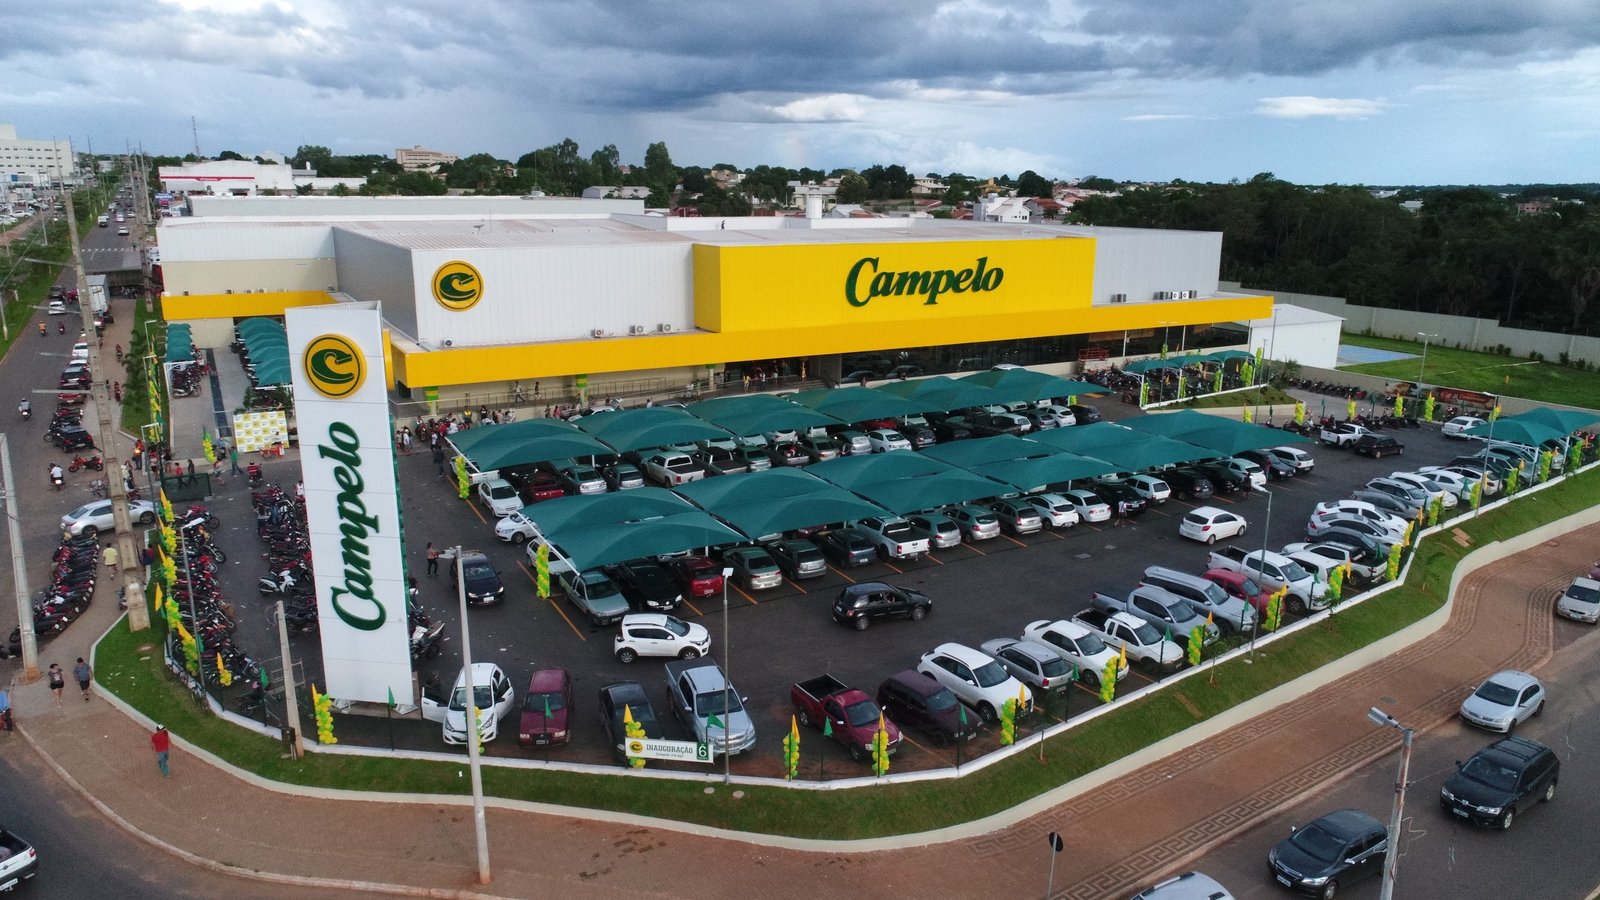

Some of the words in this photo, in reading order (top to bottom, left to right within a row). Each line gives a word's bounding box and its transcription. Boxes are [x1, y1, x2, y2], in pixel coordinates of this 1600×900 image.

[845, 256, 1004, 307] Campelo
[318, 421, 387, 631] Campelo
[646, 744, 693, 753] INAUGURAÇÃO
